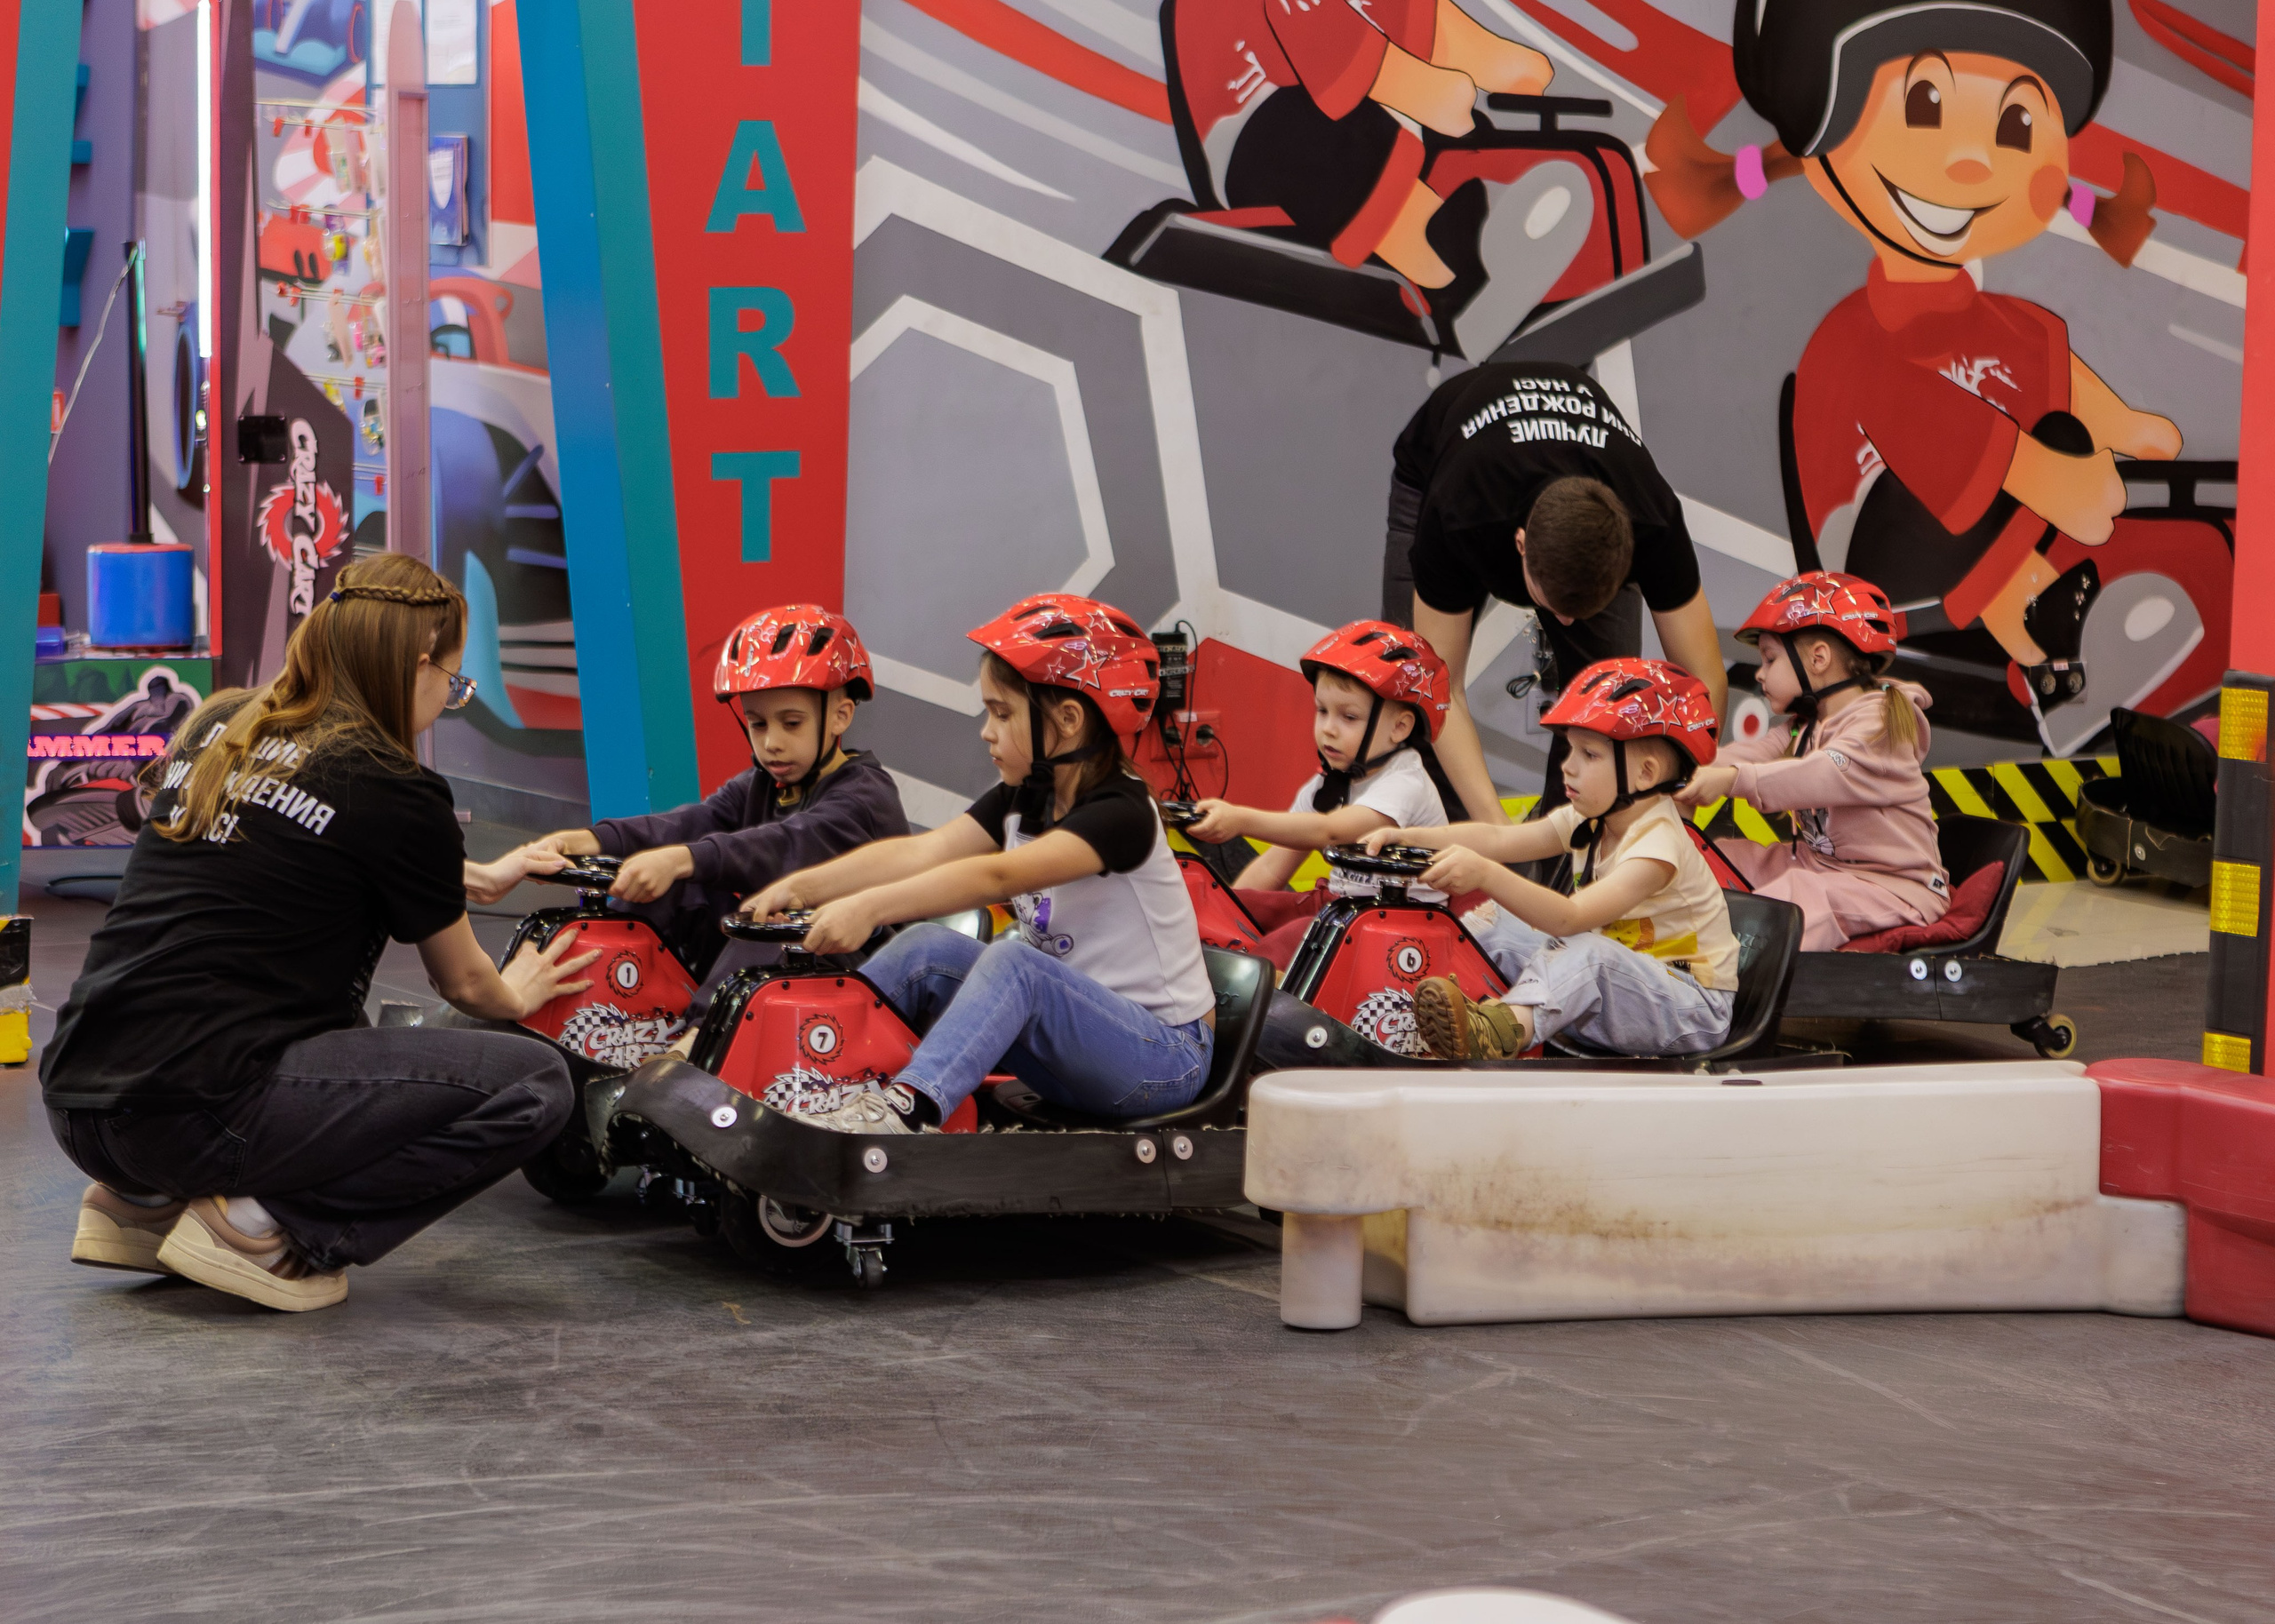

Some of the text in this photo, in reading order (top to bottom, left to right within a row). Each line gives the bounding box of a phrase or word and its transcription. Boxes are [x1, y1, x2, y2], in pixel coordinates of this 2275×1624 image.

[1512, 378, 1594, 397] У НАС!
[1460, 392, 1597, 439] РОЖДЕНИЯ
[1506, 418, 1609, 449] ЛУЧШИЕ
[289, 418, 319, 617] CRAZY CART
[1406, 952, 1417, 968] 6
[589, 1018, 688, 1051] CRAZY
[818, 1031, 828, 1049] 7
